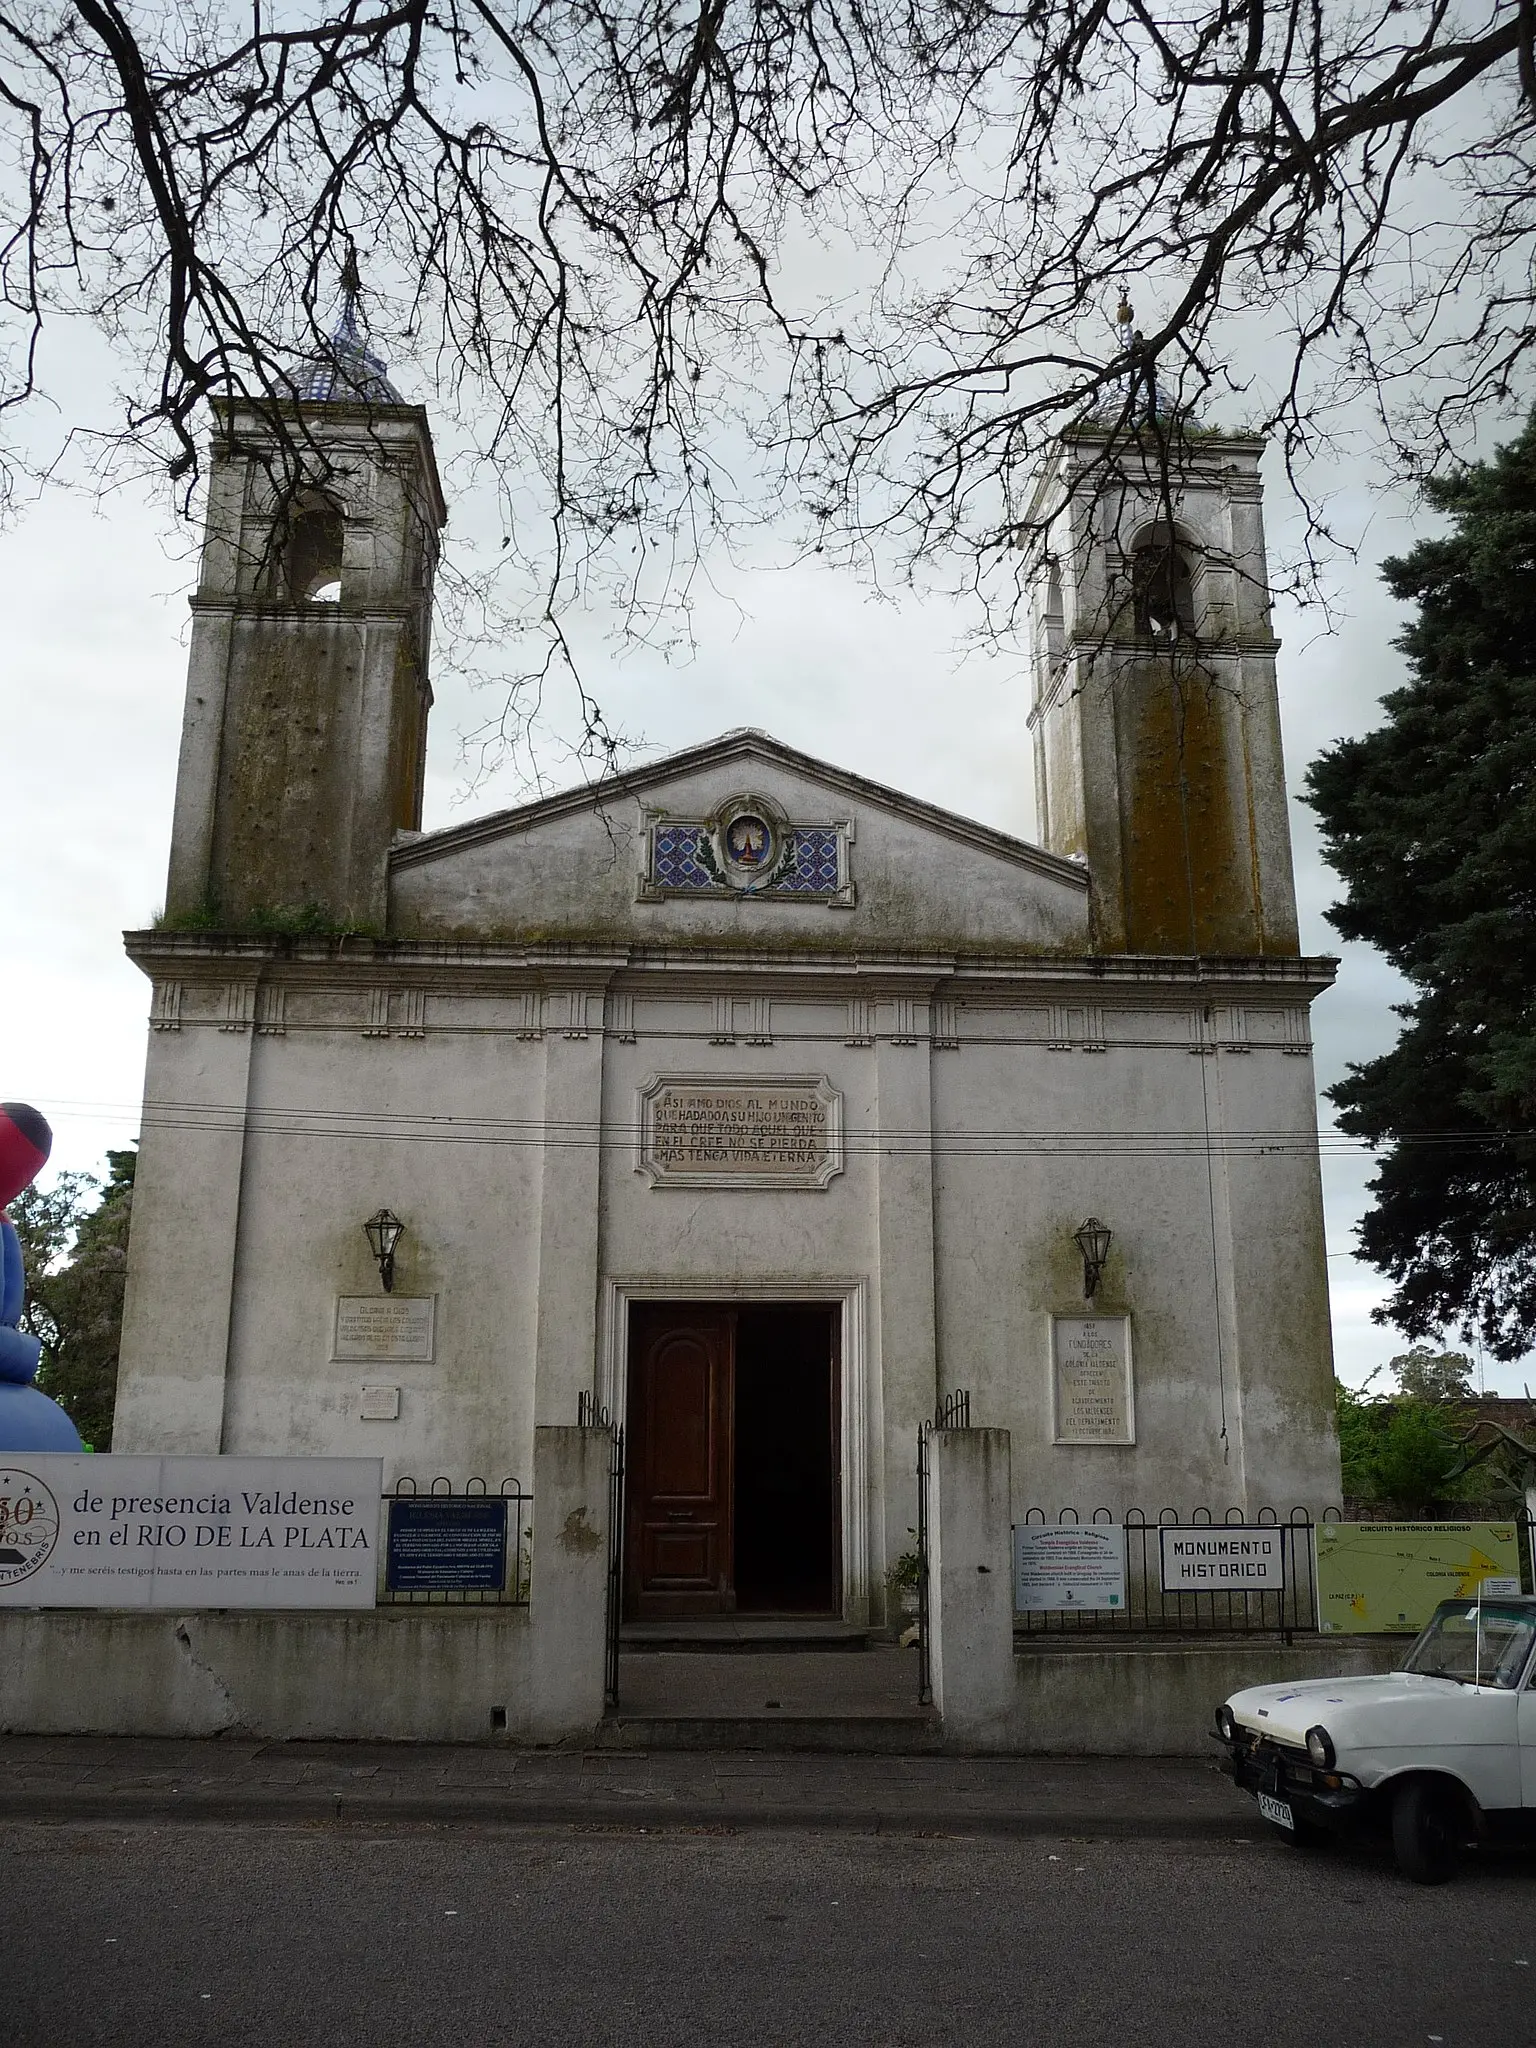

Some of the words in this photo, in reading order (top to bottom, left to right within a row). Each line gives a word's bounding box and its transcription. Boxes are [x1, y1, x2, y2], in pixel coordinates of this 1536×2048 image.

[687, 1099, 713, 1109] AMO
[716, 1099, 742, 1109] DIOS
[747, 1099, 762, 1110] AL
[768, 1100, 818, 1110] MUNDO
[730, 1111, 746, 1122] SU
[748, 1111, 772, 1123] HIJO
[656, 1122, 687, 1133] PARA
[690, 1123, 714, 1134] QUE
[717, 1123, 748, 1135] TODO
[729, 1137, 745, 1148] NO
[750, 1138, 764, 1148] SE
[770, 1138, 816, 1149] PIERDA
[660, 1150, 685, 1161] MAS
[687, 1150, 728, 1161] TENGA
[733, 1151, 759, 1162] VIDA
[763, 1152, 816, 1163] ETERNA
[73, 1489, 103, 1513] de
[109, 1494, 231, 1521] presencia
[241, 1491, 354, 1516] Valdense
[1360, 1525, 1393, 1533] CIRCUITO
[1394, 1525, 1433, 1533] HISTÓRICO
[1434, 1525, 1472, 1533] RELIGIOSO
[73, 1529, 101, 1546] en
[109, 1523, 129, 1546] el
[136, 1525, 187, 1547] RIO
[193, 1526, 232, 1547] DE
[239, 1526, 275, 1548] LA
[283, 1527, 370, 1549] PLATA
[1174, 1541, 1273, 1556] MONUMENTO
[7, 1542, 49, 1579] TENEBRIS
[87, 1566, 116, 1575] seréis
[118, 1567, 155, 1578] testigos
[157, 1566, 183, 1576] hasta
[199, 1567, 213, 1576] las
[216, 1568, 247, 1578] partes
[249, 1569, 270, 1577] mas
[271, 1568, 305, 1577] leanas
[308, 1568, 320, 1577] de
[321, 1568, 331, 1577] la
[333, 1568, 362, 1578] tierra.
[1181, 1563, 1268, 1578] HISTORICO
